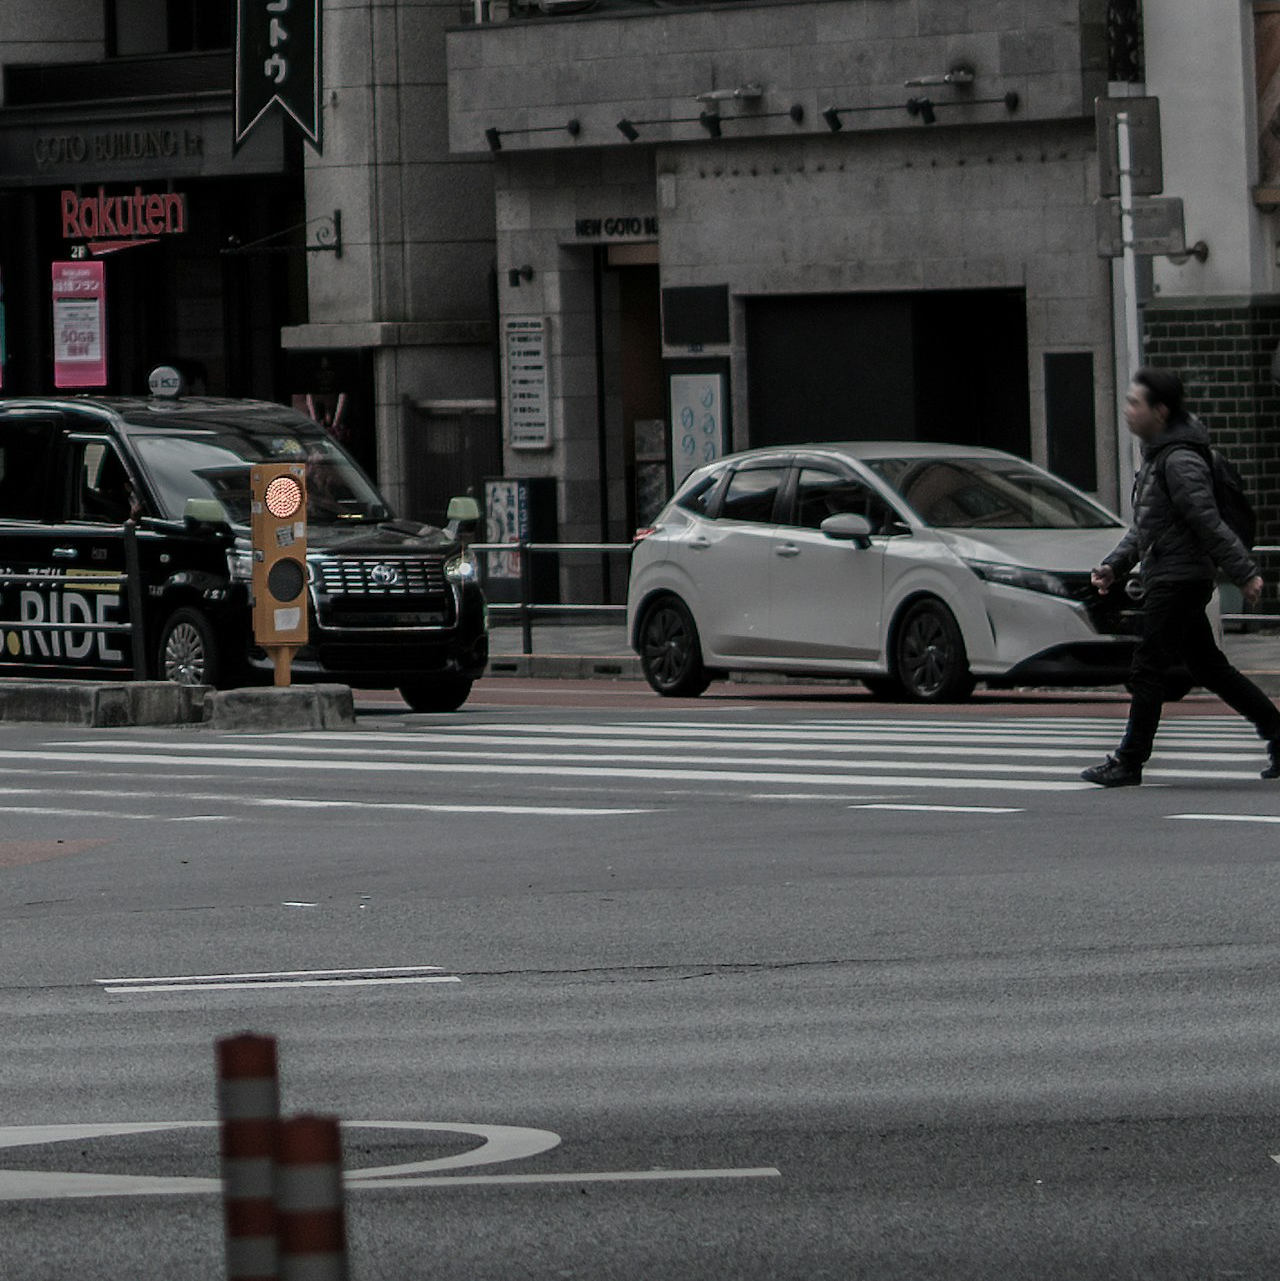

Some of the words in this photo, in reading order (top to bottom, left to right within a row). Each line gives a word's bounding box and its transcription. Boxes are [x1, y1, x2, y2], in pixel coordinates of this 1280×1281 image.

[60, 185, 186, 239] Rakuten
[575, 219, 602, 236] NEW
[604, 217, 642, 236] GOTO
